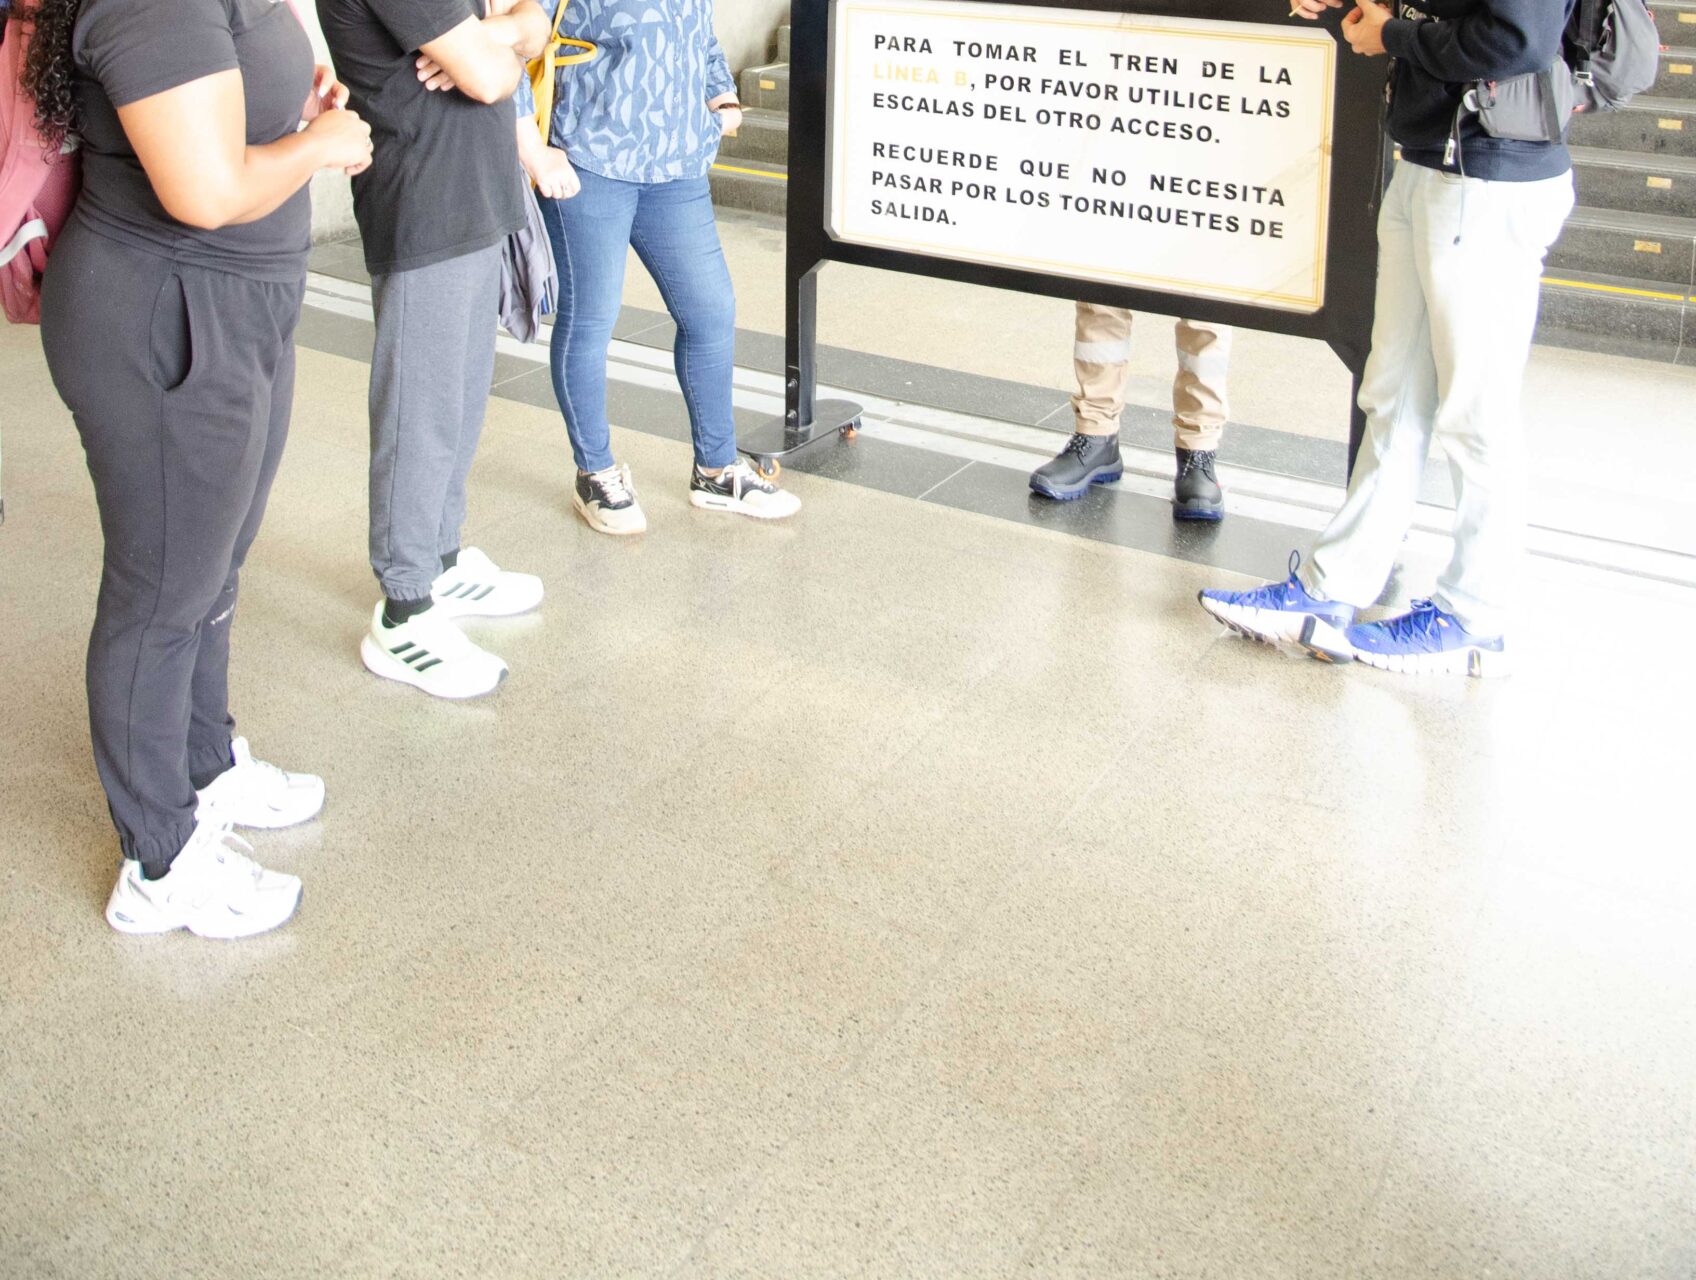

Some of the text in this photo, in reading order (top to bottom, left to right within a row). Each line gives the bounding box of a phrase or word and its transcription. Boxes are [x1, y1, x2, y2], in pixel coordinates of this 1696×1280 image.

[873, 34, 1292, 86] PARA TOMAR EL TREN DE LA
[873, 92, 1220, 144] ESCALAS DEL OTRO ACCESO.
[985, 73, 1031, 93] POR
[1041, 78, 1118, 101] FAVOR
[1128, 86, 1230, 113] UTILICE
[1241, 97, 1290, 118] LAS
[873, 142, 1285, 207] RECUERDE QUE NO NECESITA
[871, 199, 958, 225] SALIDA.
[872, 171, 1283, 239] PASAR POR LOS TORNIQUETES DE
